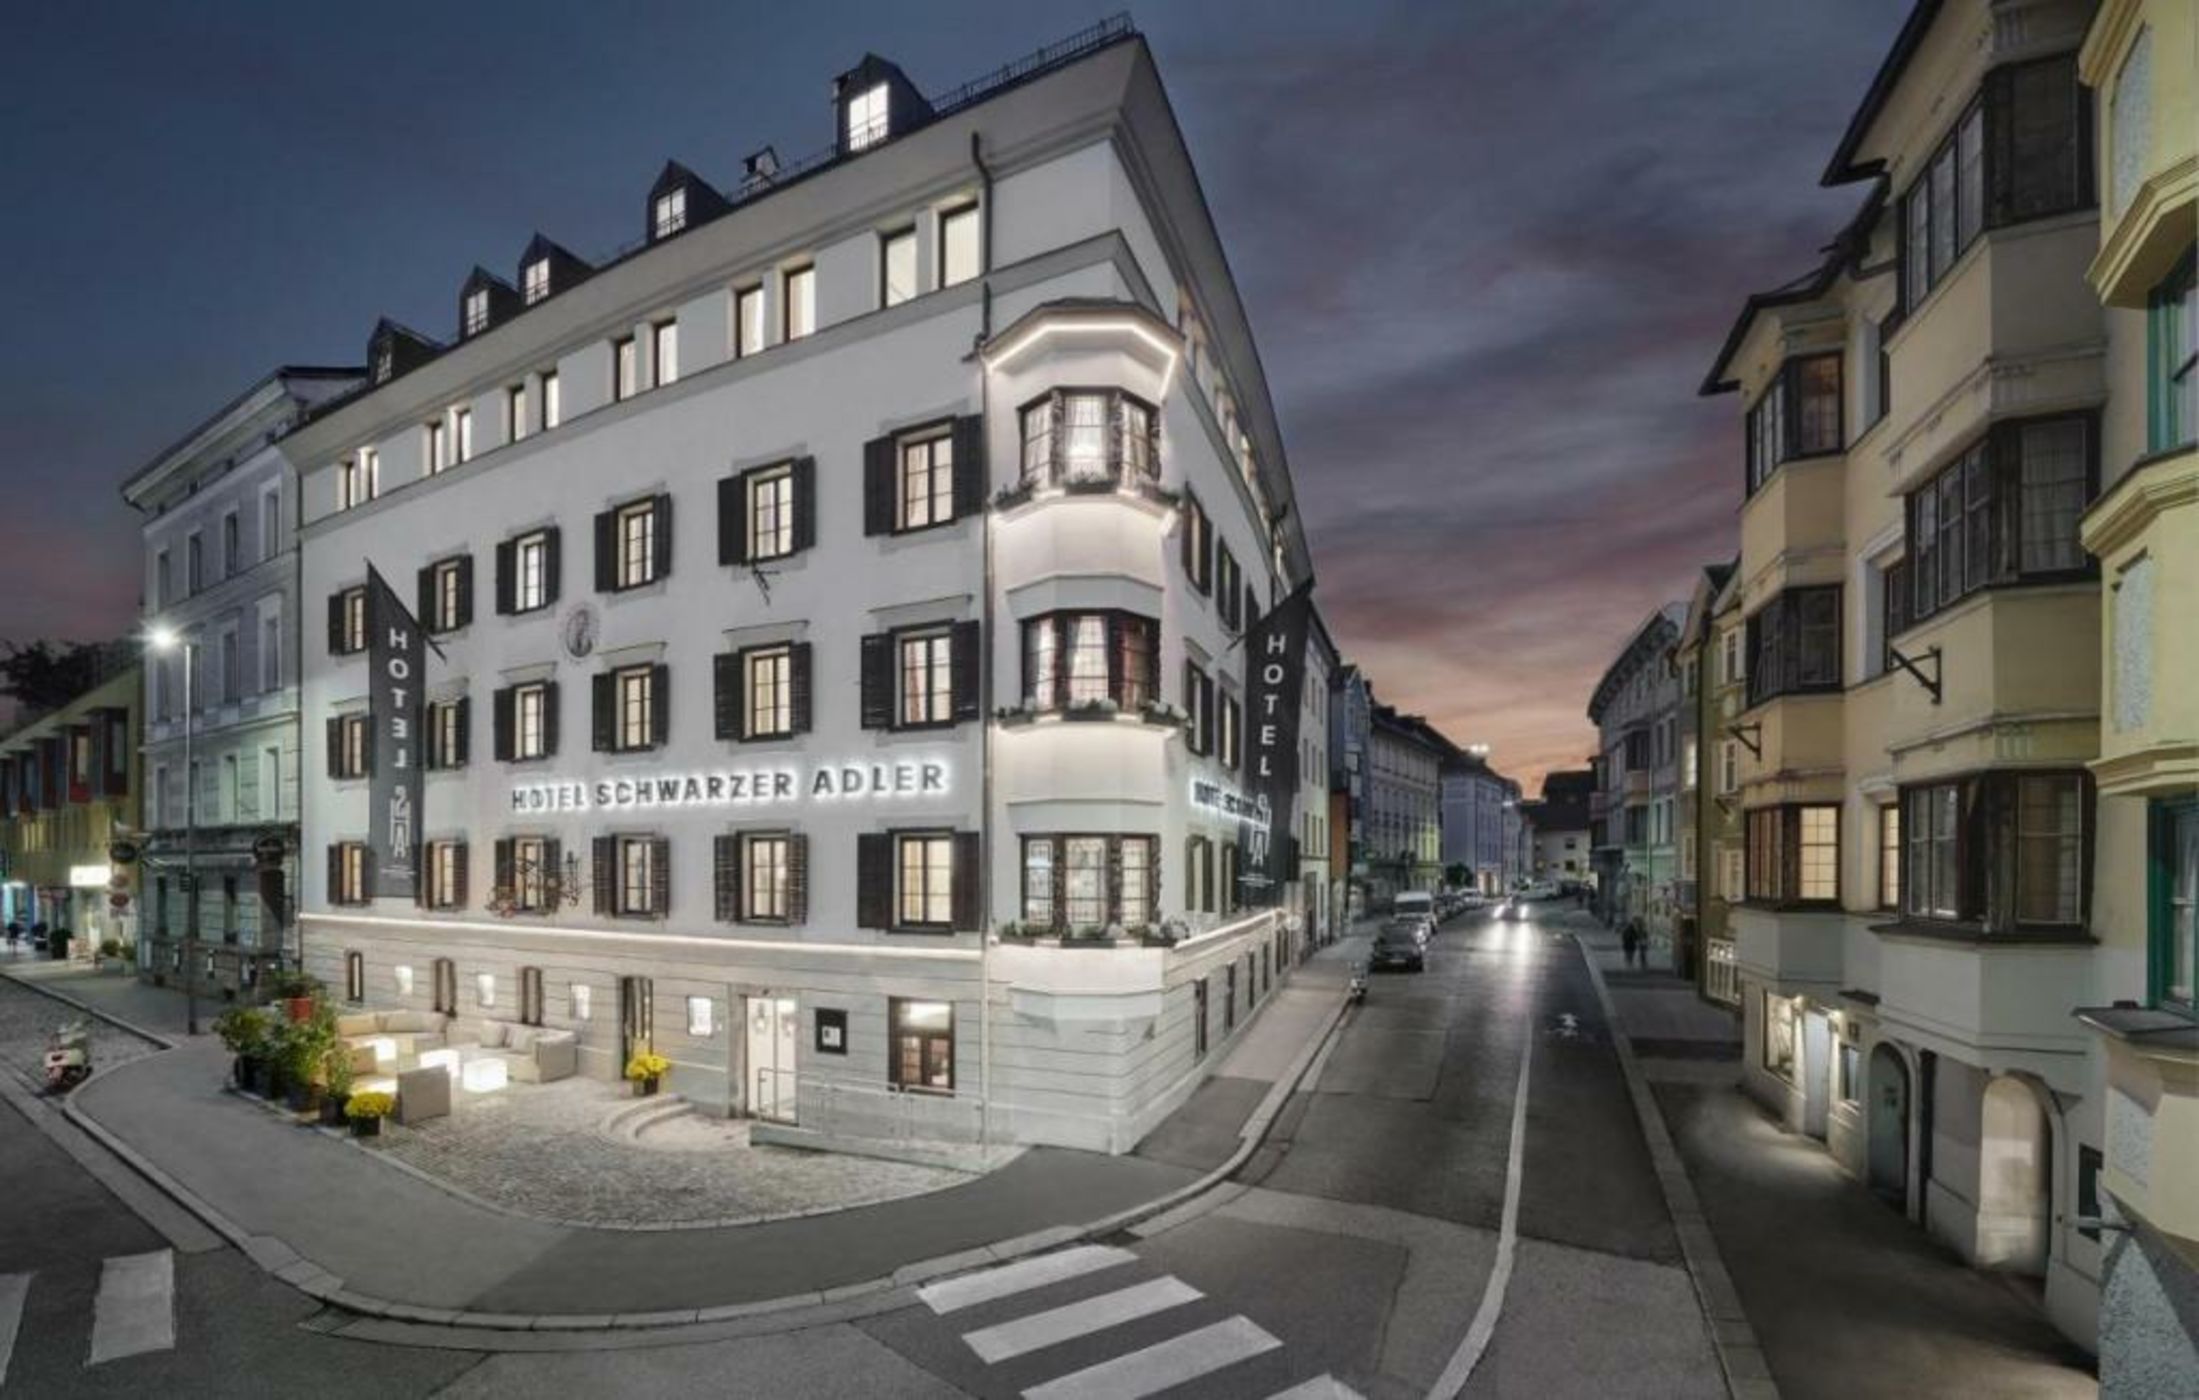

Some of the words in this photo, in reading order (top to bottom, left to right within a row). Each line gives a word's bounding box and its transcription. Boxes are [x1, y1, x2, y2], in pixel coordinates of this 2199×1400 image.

[1259, 633, 1286, 777] HOTEL
[512, 784, 585, 811] HOTEL
[595, 772, 793, 806] SCHWARZER
[811, 764, 944, 794] ADLER
